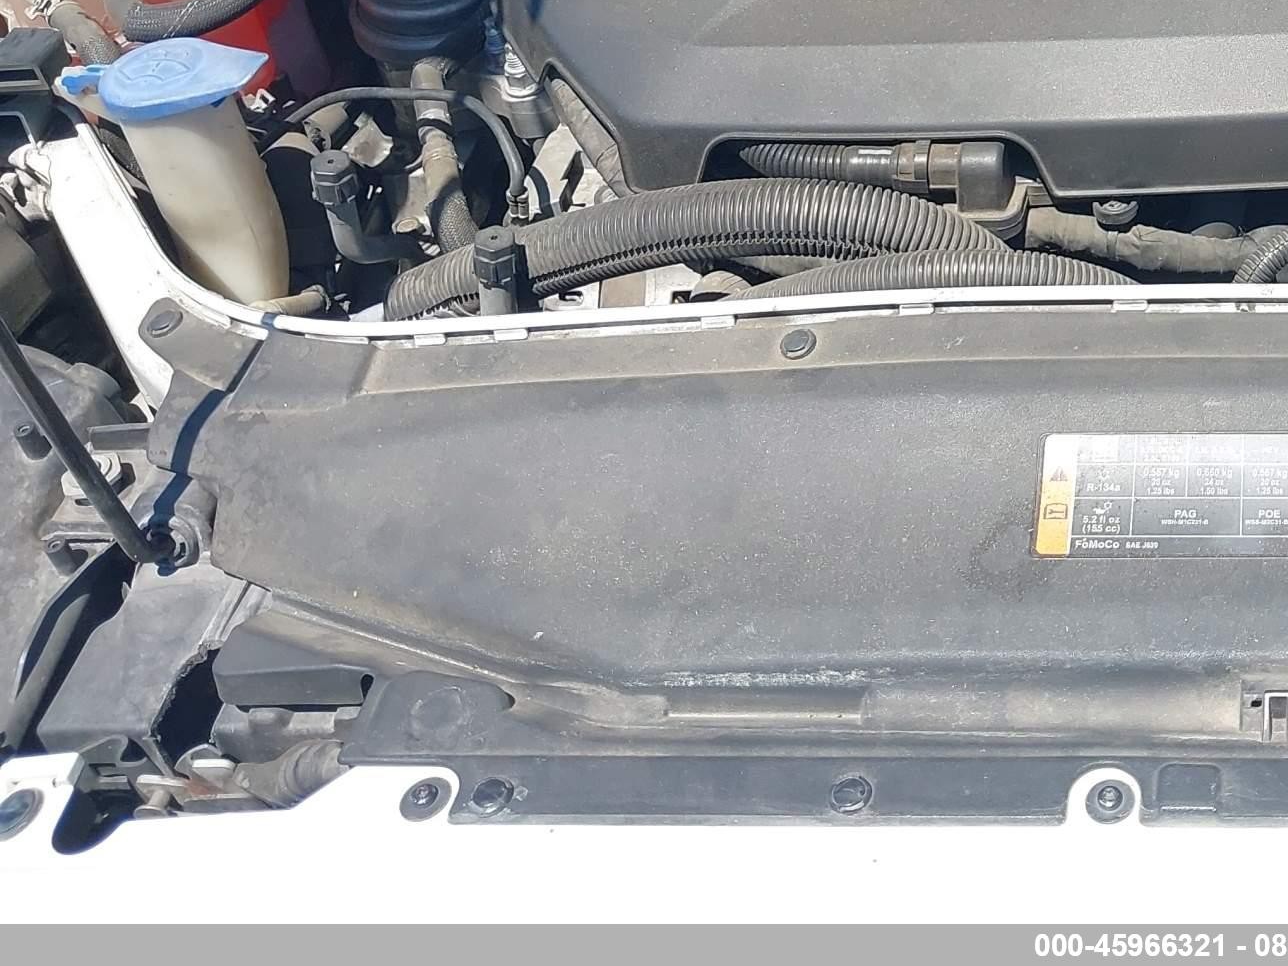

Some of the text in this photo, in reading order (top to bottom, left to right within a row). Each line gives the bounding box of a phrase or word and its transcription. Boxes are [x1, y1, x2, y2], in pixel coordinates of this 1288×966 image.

[1086, 483, 1120, 492] R-134a
[1163, 487, 1175, 495] lbs
[1174, 509, 1197, 519] PAG
[1258, 509, 1281, 519] POE
[1082, 515, 1097, 523] 5.2
[1099, 515, 1106, 524] fl
[1082, 524, 1121, 534] (155 cc)
[1075, 539, 1120, 549] FoMoCo
